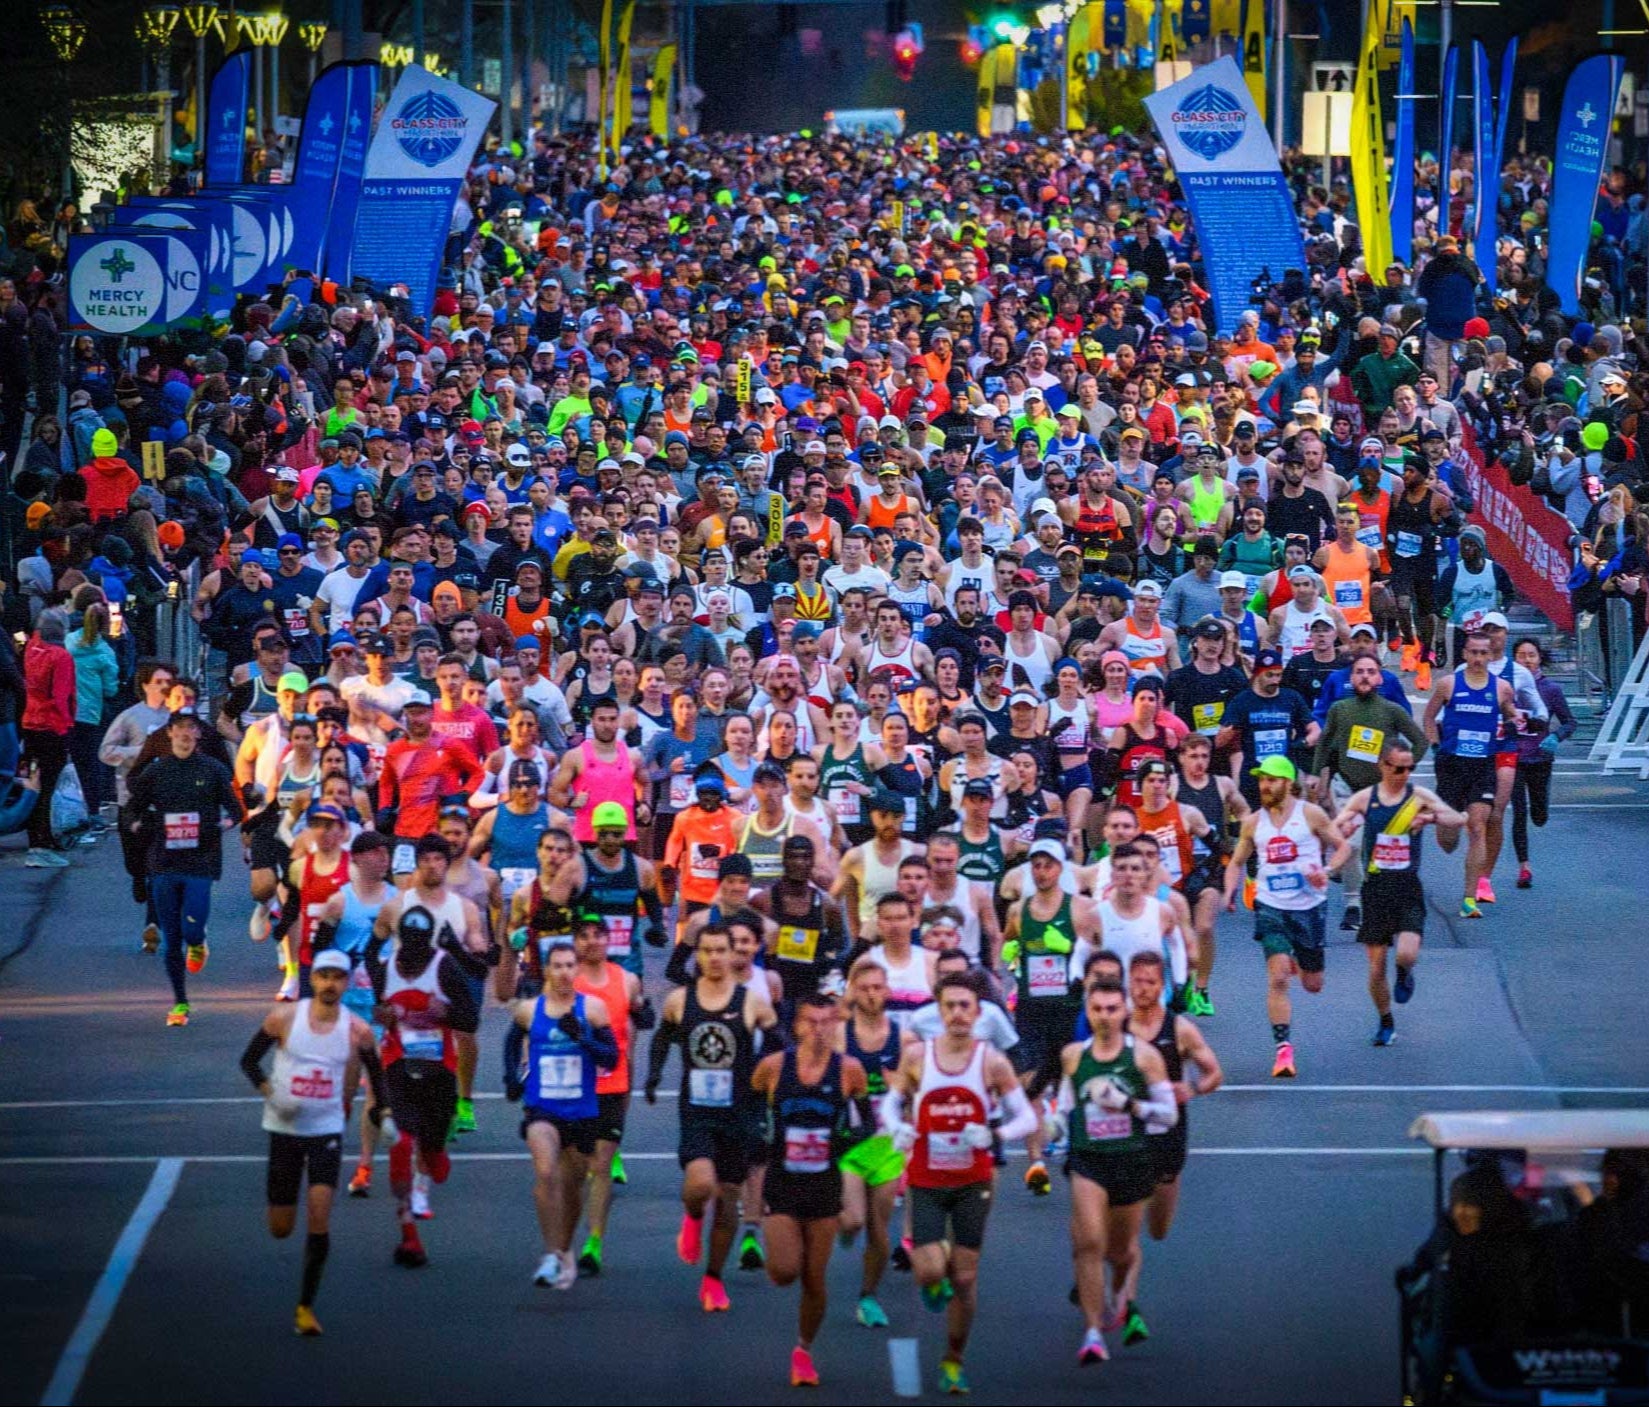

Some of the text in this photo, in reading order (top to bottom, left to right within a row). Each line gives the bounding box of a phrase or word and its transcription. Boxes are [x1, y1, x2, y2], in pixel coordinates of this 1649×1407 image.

[1171, 110, 1247, 122] GLASS CITY
[391, 118, 468, 129] GLASS CITY
[1190, 177, 1277, 185] PAST WINNERS
[364, 186, 451, 195] PAST WINNERS
[89, 290, 144, 301] MERCY
[86, 304, 147, 316] HEALTH
[771, 498, 781, 532] 300
